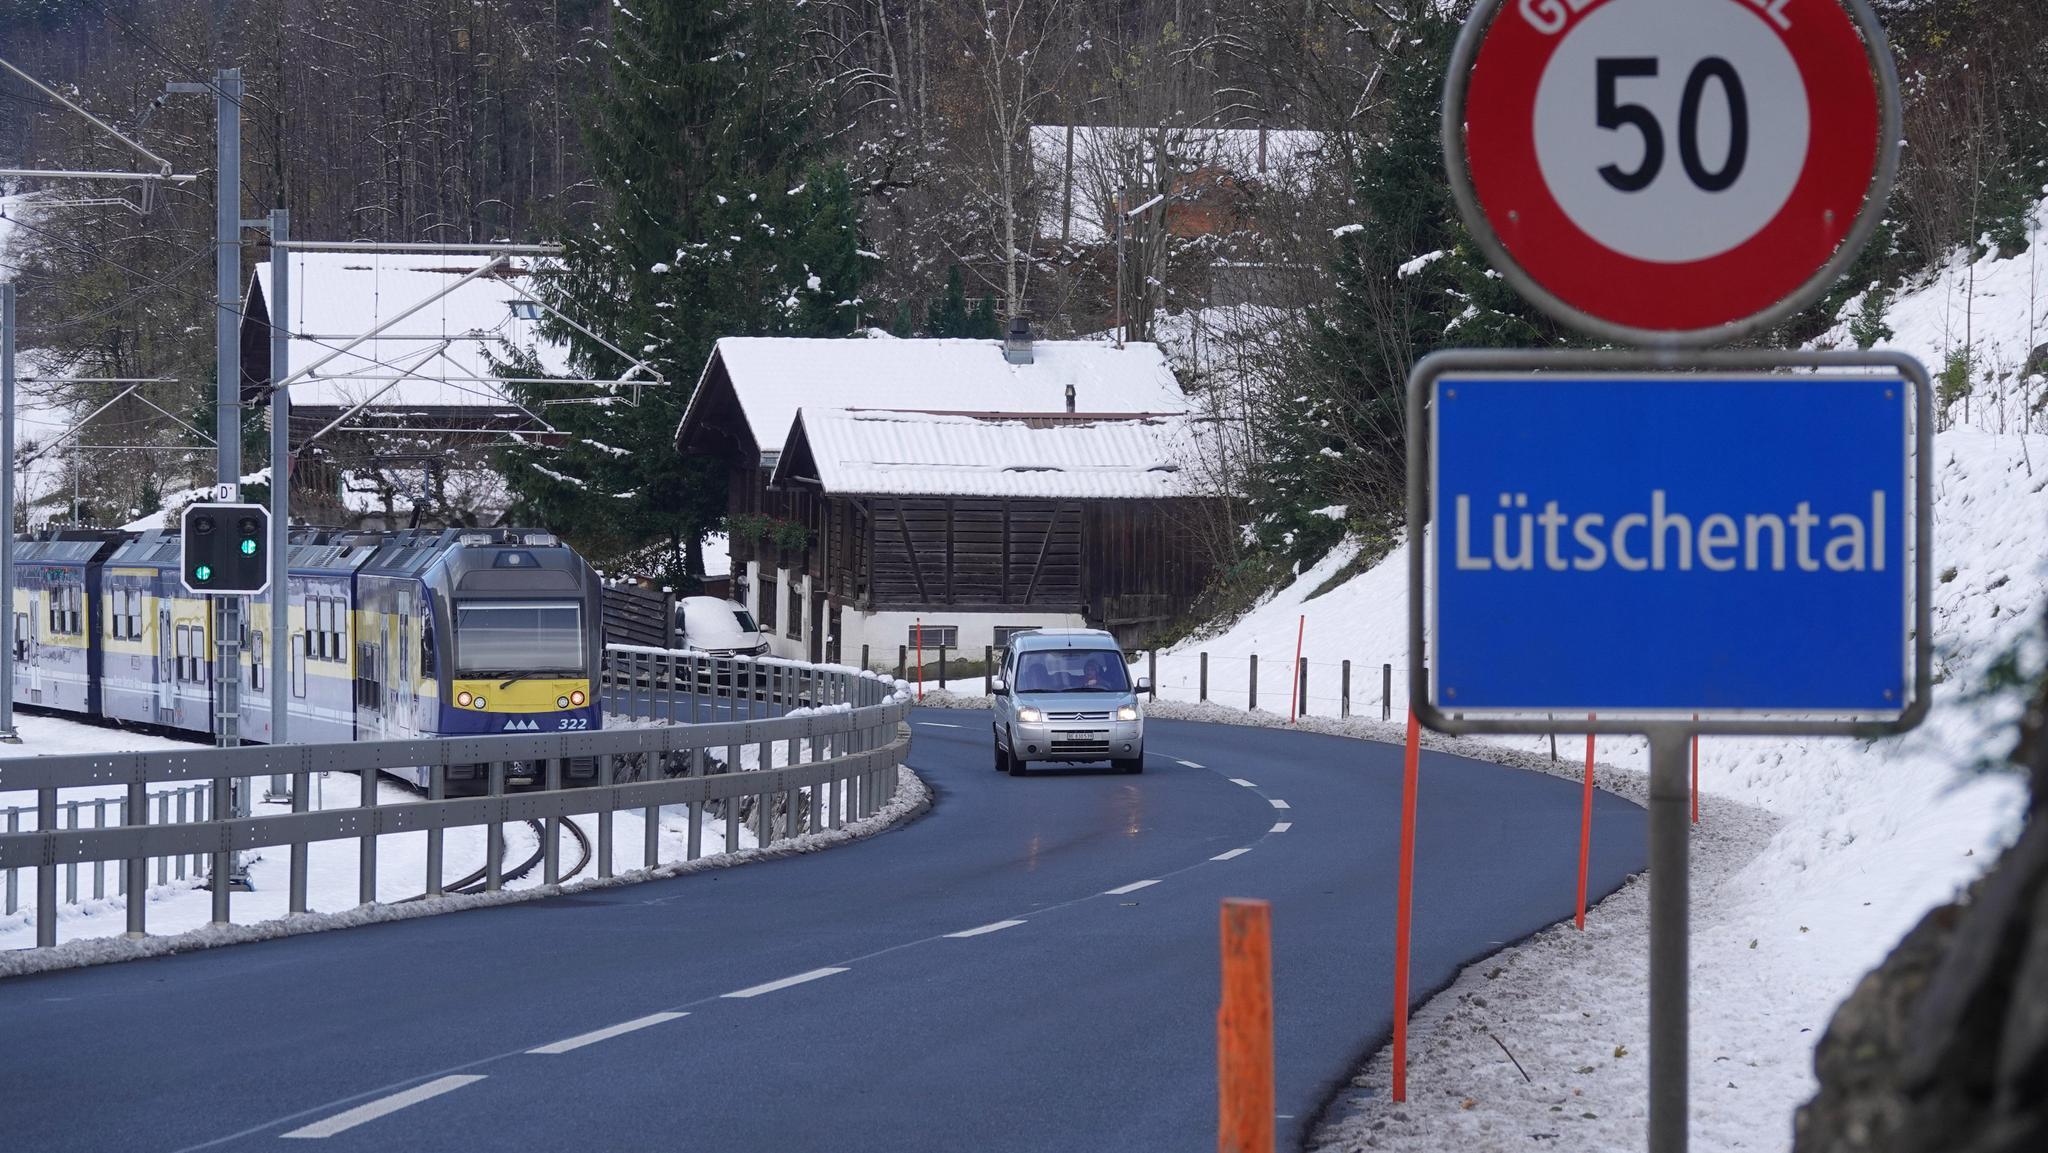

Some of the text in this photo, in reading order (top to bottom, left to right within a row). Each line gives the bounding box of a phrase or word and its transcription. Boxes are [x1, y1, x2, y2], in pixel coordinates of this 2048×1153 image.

[1595, 56, 1749, 194] 50
[1455, 489, 1887, 573] Lütschental
[558, 718, 587, 730] 322
